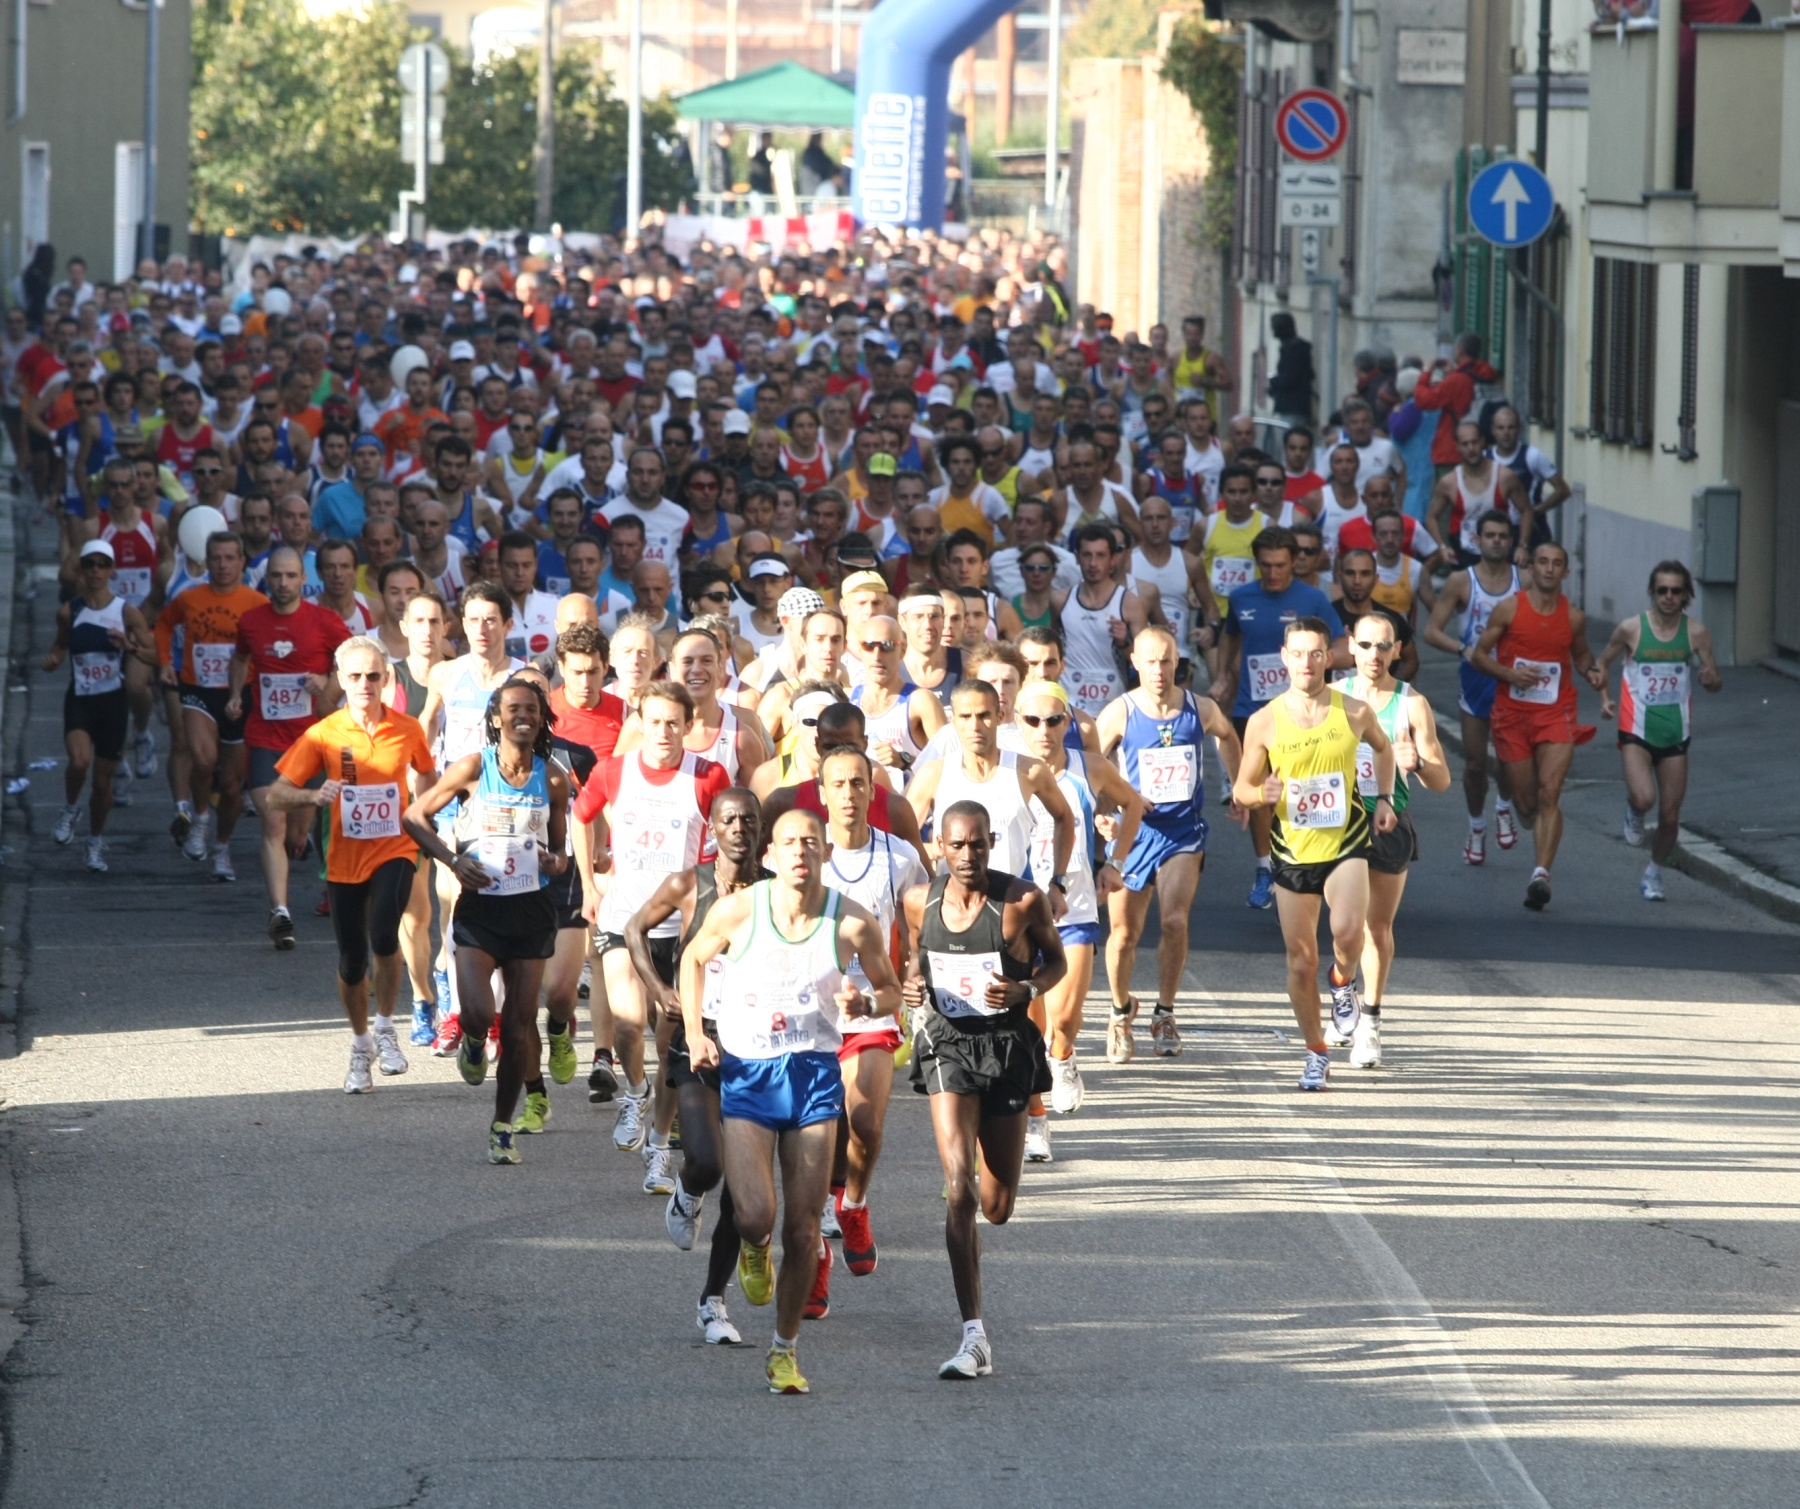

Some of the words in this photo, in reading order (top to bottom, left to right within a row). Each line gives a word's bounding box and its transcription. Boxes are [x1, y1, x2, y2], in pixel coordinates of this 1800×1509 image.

[1219, 570, 1247, 584] 474
[120, 582, 137, 594] 31
[82, 663, 112, 681] 989
[1256, 668, 1288, 685] 309
[1077, 684, 1110, 699] 409
[1648, 677, 1678, 692] 279
[269, 689, 302, 704] 487
[1152, 765, 1190, 784] 272
[1297, 791, 1335, 812] 690
[351, 802, 391, 821] 670
[636, 830, 665, 850] 49
[504, 857, 515, 875] 3
[960, 976, 973, 997] 5
[771, 1011, 787, 1032] 8
